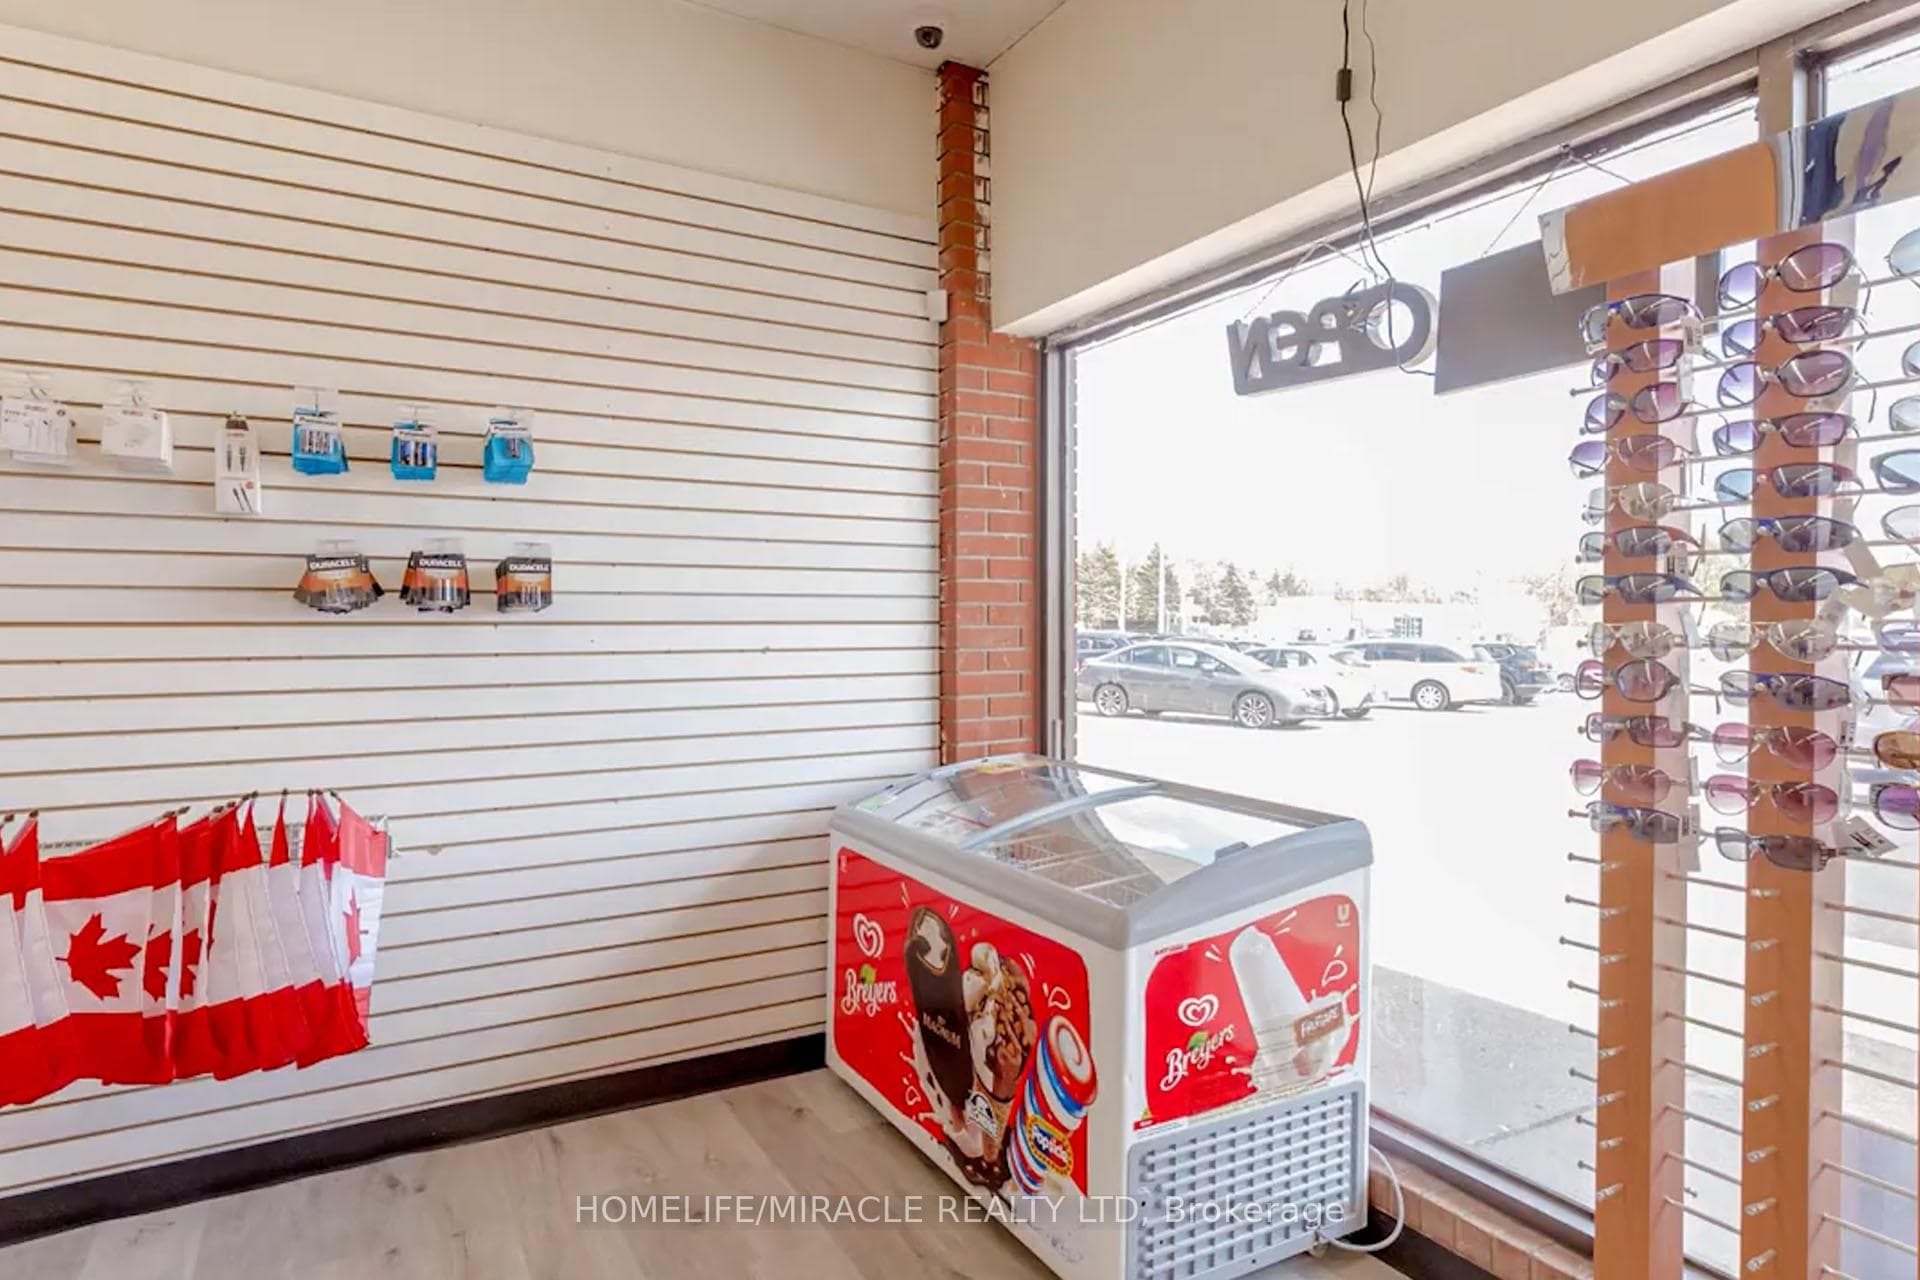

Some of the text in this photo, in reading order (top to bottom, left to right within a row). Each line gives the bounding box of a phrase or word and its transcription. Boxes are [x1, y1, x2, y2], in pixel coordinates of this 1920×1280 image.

[419, 559, 464, 568] DURACELL
[508, 563, 550, 572] DURACELL
[840, 967, 897, 1017] Breyers
[1159, 1024, 1235, 1092] Breyers
